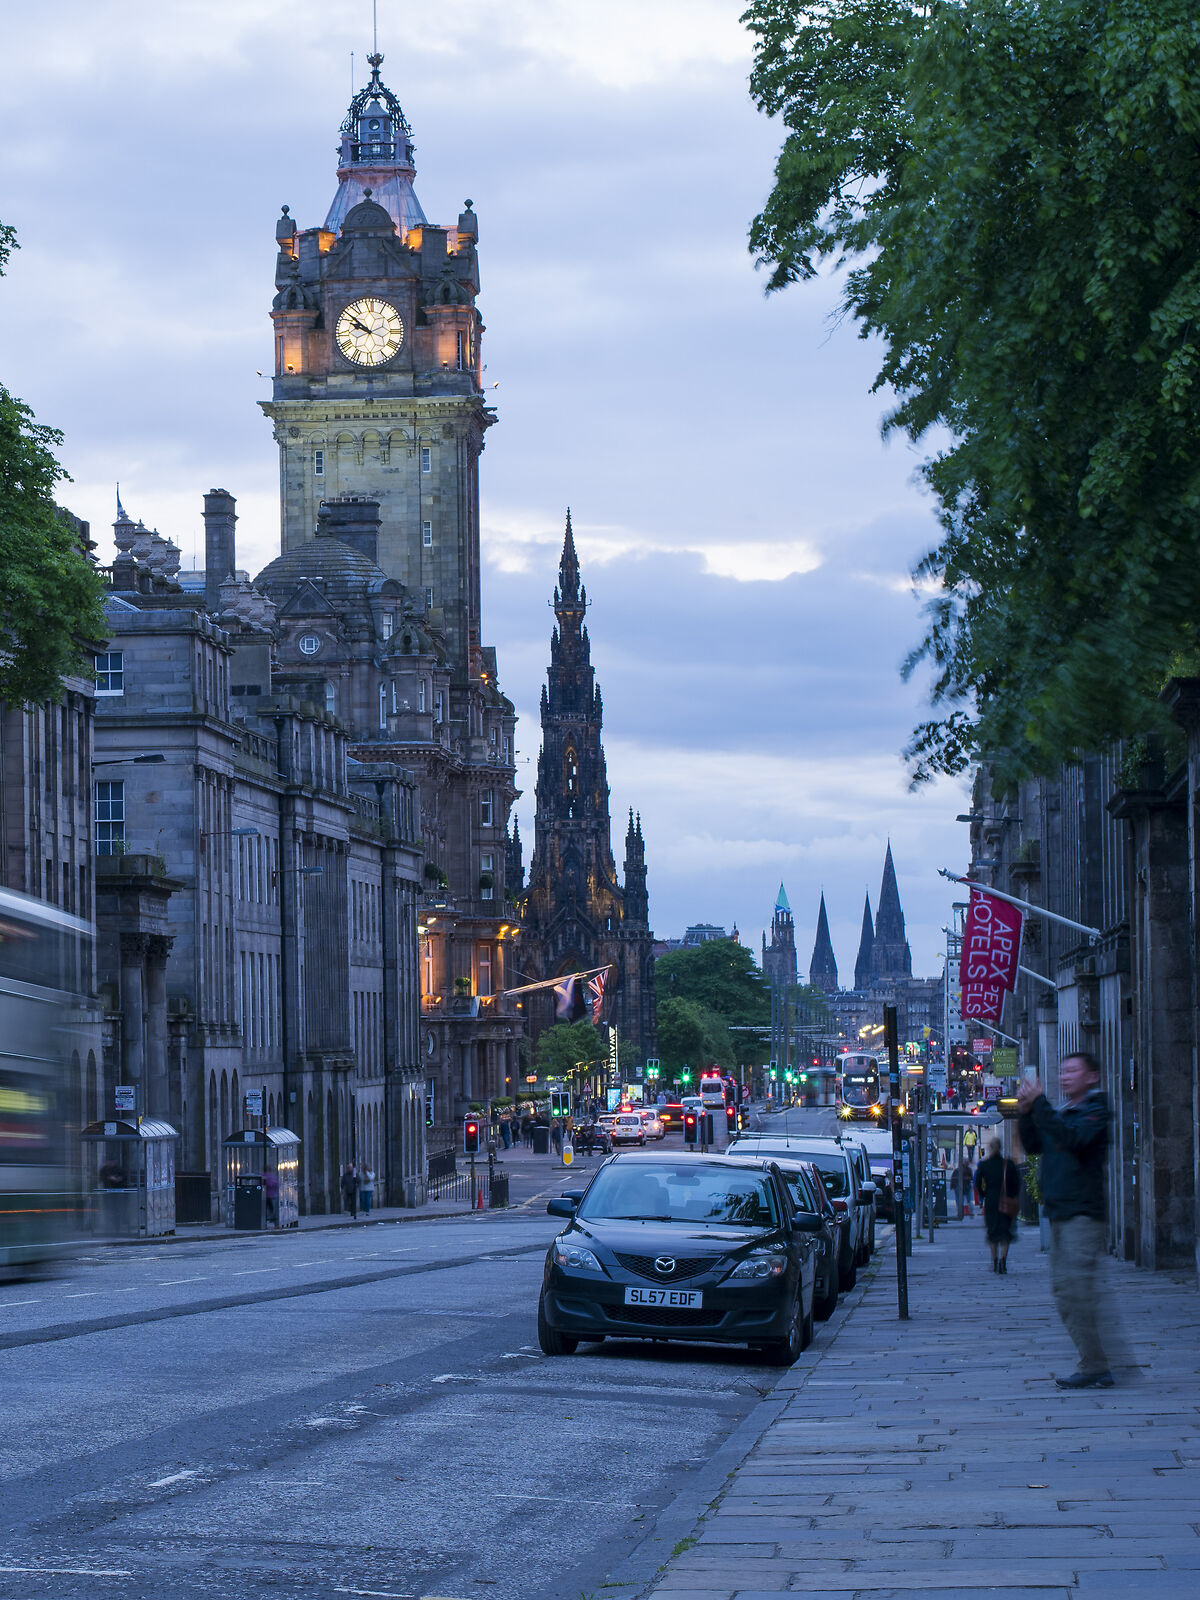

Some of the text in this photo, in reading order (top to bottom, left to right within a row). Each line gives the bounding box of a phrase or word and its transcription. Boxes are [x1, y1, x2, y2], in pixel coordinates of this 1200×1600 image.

[967, 888, 992, 979] HOTELS
[988, 918, 1014, 984] APEX
[631, 1289, 697, 1306] SL57 EDF
